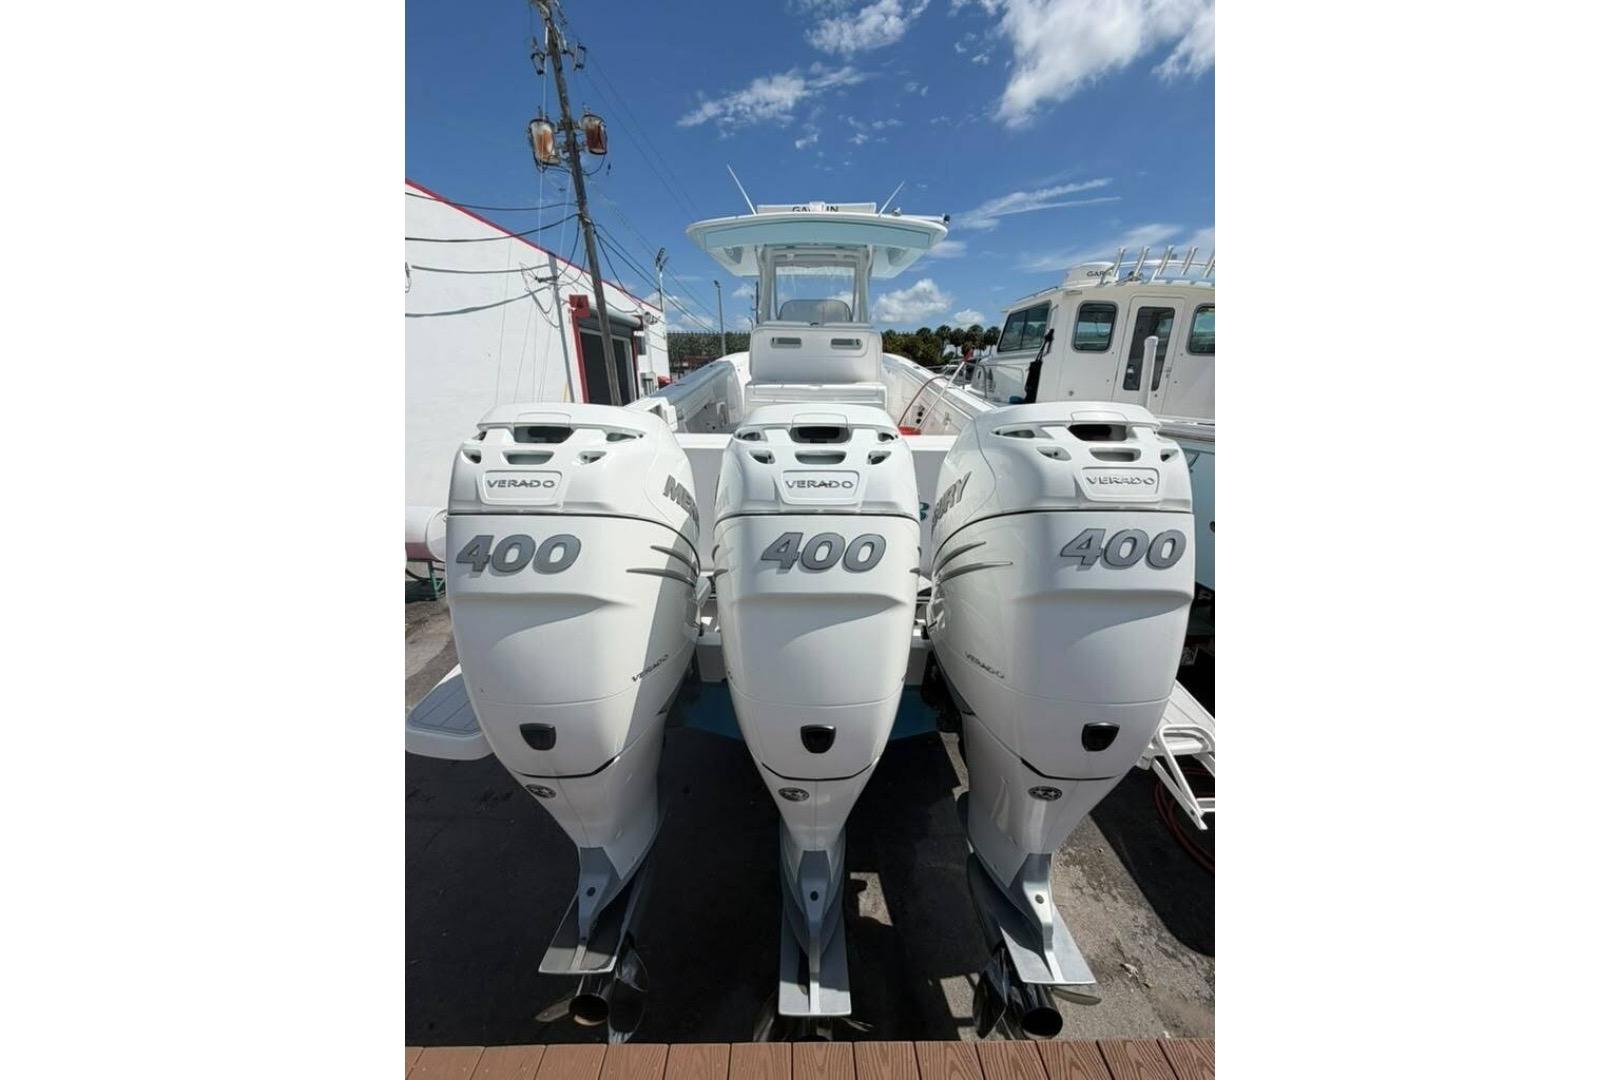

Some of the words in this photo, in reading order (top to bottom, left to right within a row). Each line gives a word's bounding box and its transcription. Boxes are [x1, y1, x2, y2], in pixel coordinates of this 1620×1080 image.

[487, 480, 555, 488] VERADO
[785, 480, 854, 488] VERADO
[1086, 477, 1155, 485] VERADO
[456, 533, 582, 574] 400
[760, 532, 887, 572] 400
[1060, 529, 1186, 570] 400
[632, 654, 669, 682] VERADO
